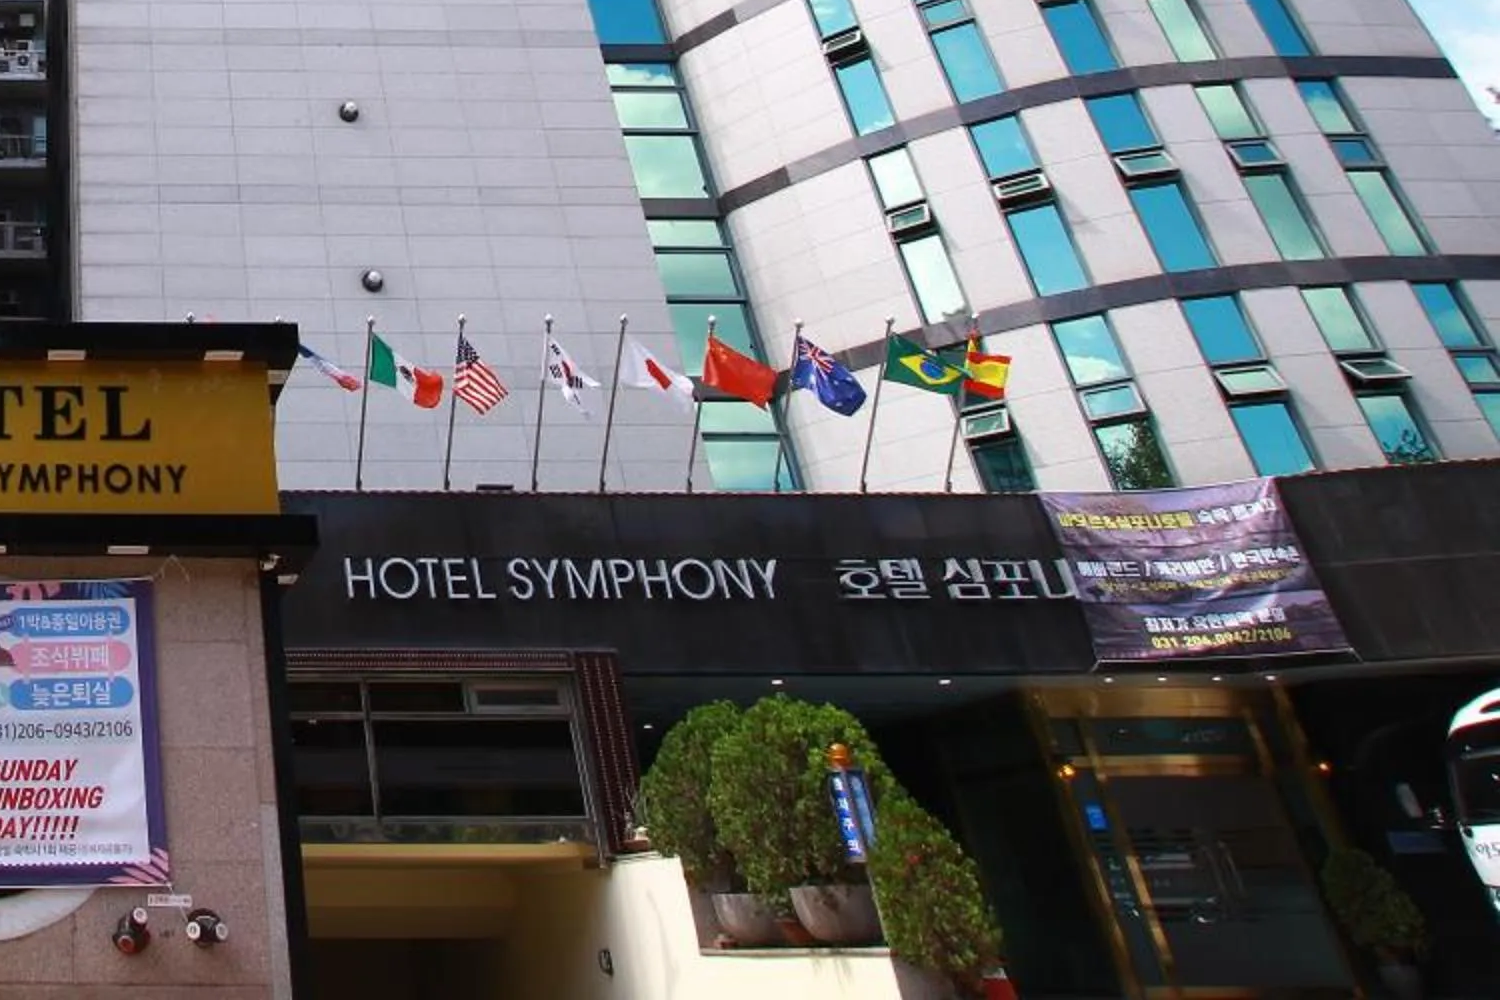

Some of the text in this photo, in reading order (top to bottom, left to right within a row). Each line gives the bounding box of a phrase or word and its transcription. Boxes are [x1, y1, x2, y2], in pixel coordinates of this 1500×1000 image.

[343, 557, 777, 600] HOTEL SYMPHONY
[835, 557, 931, 599] 호텔
[943, 557, 1080, 600] 심포니
[31, 643, 110, 669] 조식뷔페
